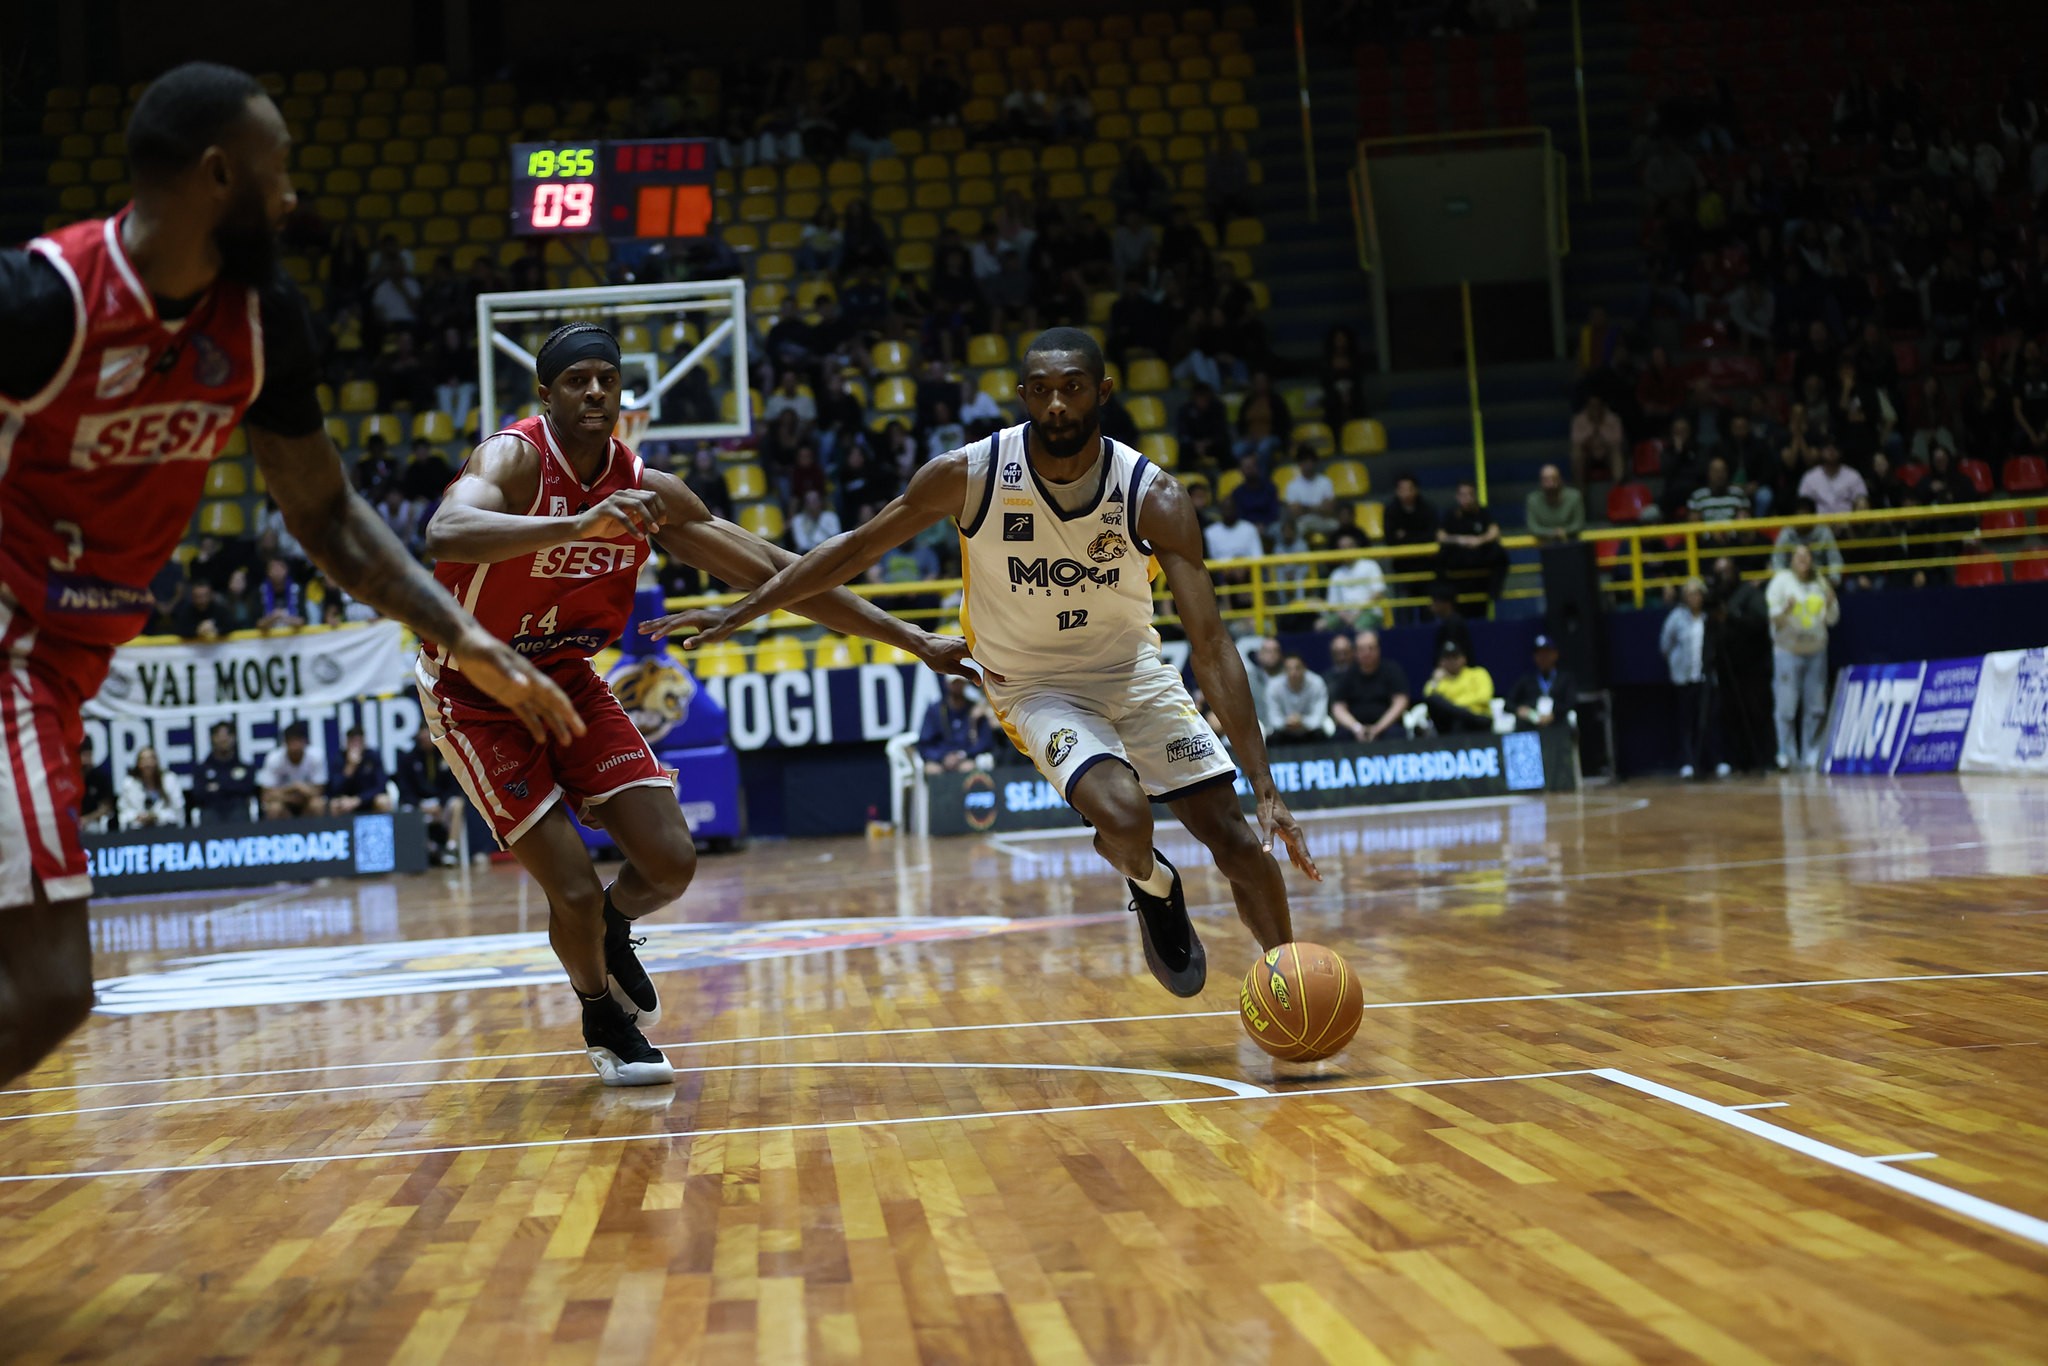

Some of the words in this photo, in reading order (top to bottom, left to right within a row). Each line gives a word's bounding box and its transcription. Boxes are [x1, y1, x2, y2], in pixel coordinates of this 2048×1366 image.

[528, 149, 594, 177] 19:55
[532, 183, 594, 227] 09
[91, 408, 220, 463] SESI
[49, 519, 84, 572] 3
[542, 547, 625, 576] SESI
[1008, 556, 1120, 588] MOGI
[514, 605, 559, 638] 14
[1056, 609, 1089, 631] 12
[137, 663, 195, 707] VAI
[215, 655, 304, 702] MOGI
[596, 748, 646, 773] Unimed
[1168, 739, 1213, 763] Náutico
[1301, 757, 1357, 791] PELA
[1356, 747, 1499, 787] DIVERSIDADE
[99, 845, 150, 877] LUTE
[150, 841, 205, 874] PELA
[205, 830, 350, 869] DIVERSIDADE
